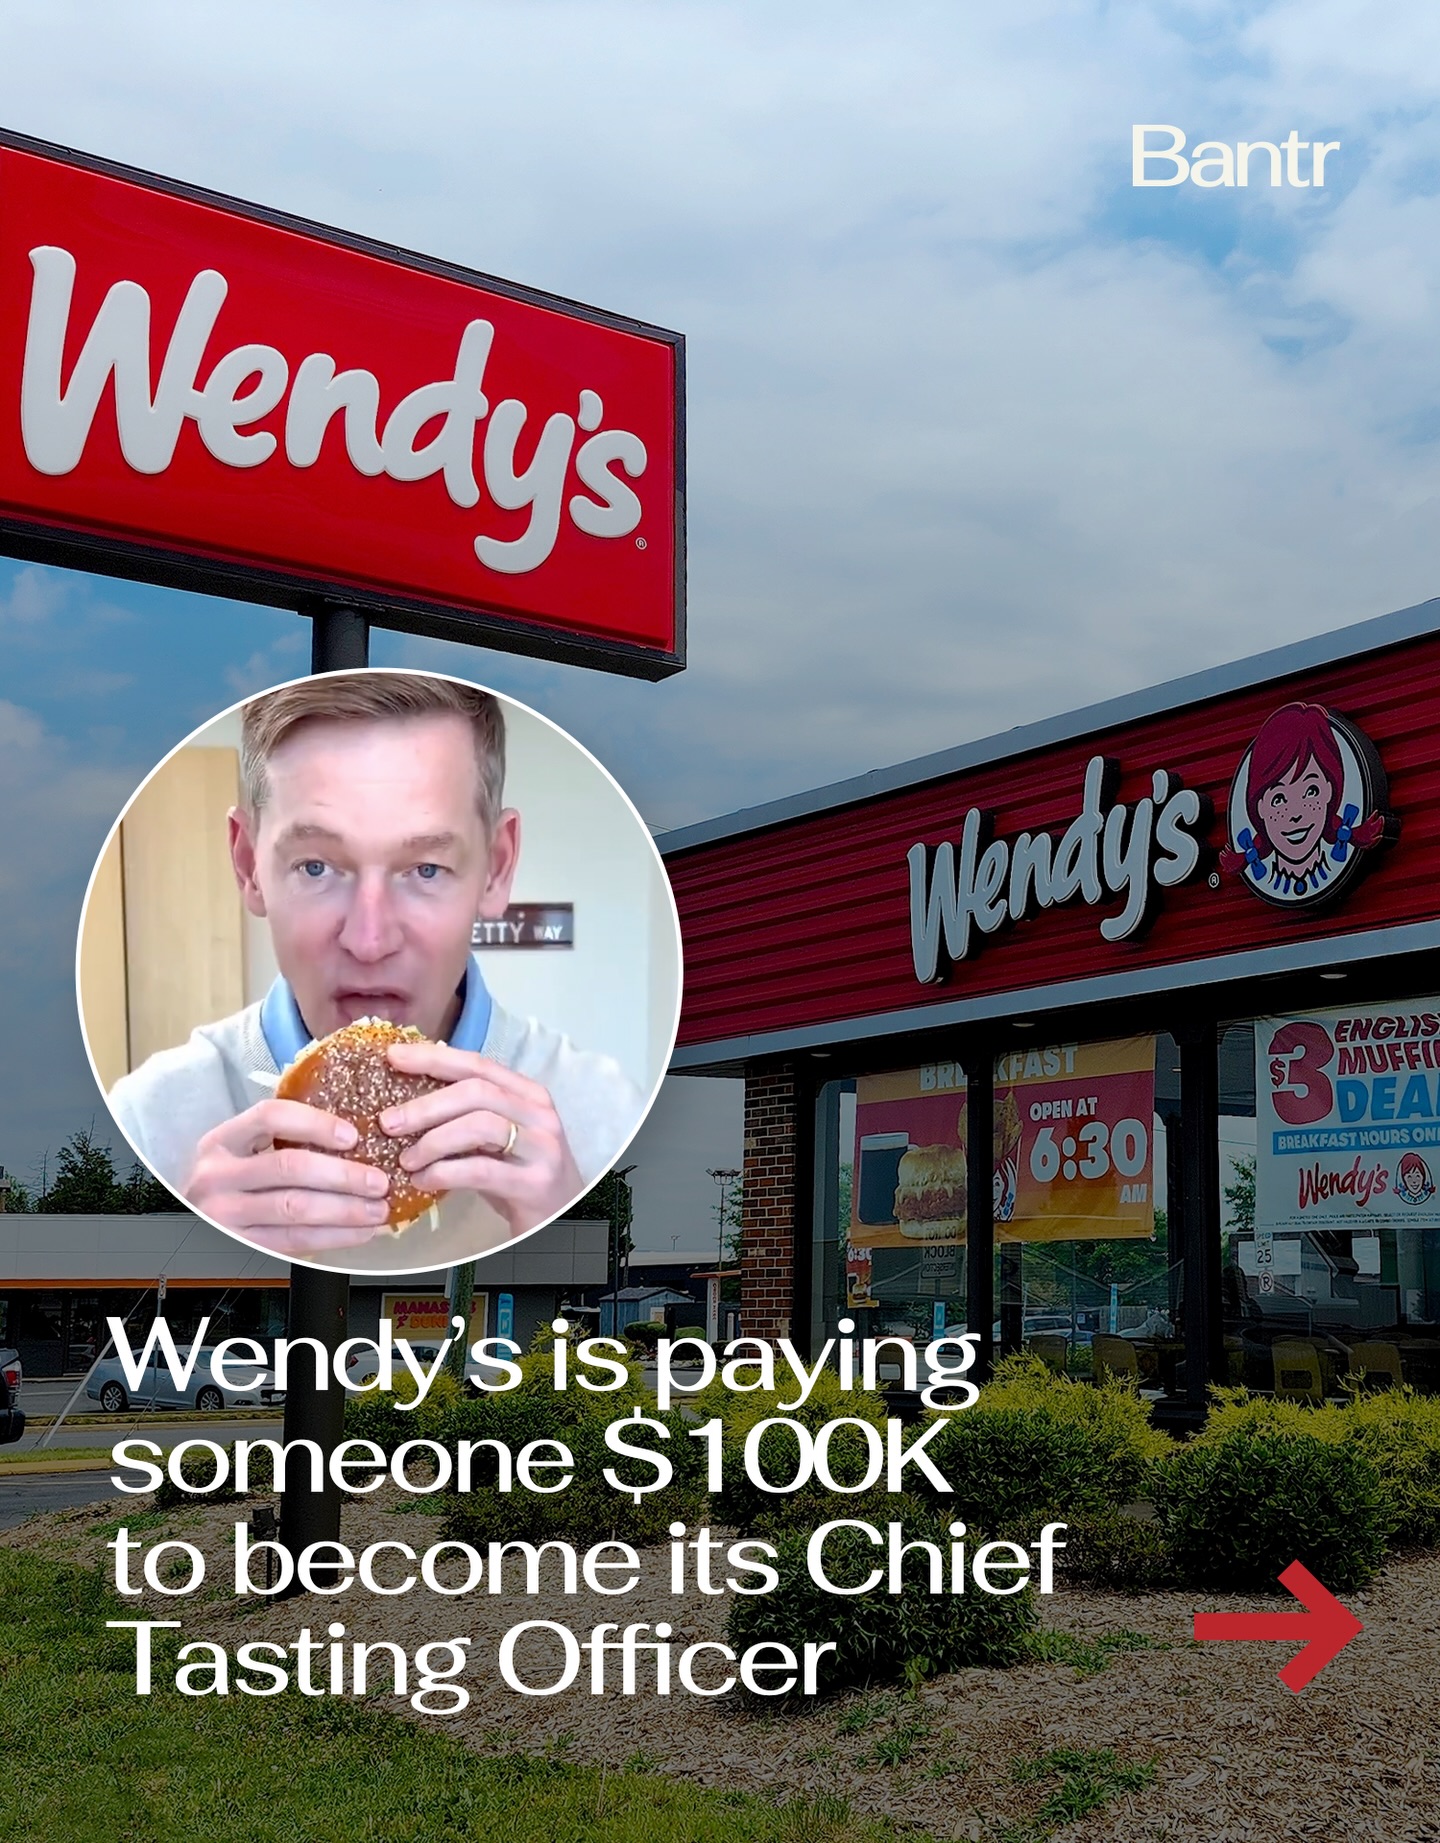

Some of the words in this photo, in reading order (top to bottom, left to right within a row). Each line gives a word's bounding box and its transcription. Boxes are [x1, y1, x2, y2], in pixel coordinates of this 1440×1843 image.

[21, 245, 648, 574] Wendy's
[906, 756, 1200, 984] Wendy's
[533, 925, 563, 940] WAY
[1334, 1013, 1440, 1043] ENGLIS
[1029, 1100, 1073, 1122] OPEN
[1075, 1096, 1099, 1116] AT
[1336, 1073, 1440, 1123] DEA
[1030, 1117, 1149, 1183] 6:30
[1277, 1131, 1358, 1151] BREAKFAST
[1359, 1126, 1410, 1146] HOURS
[1411, 1124, 1440, 1143] ON
[1119, 1184, 1148, 1204] AM
[1299, 1155, 1389, 1209] Wendy's
[1256, 1249, 1272, 1263] 25
